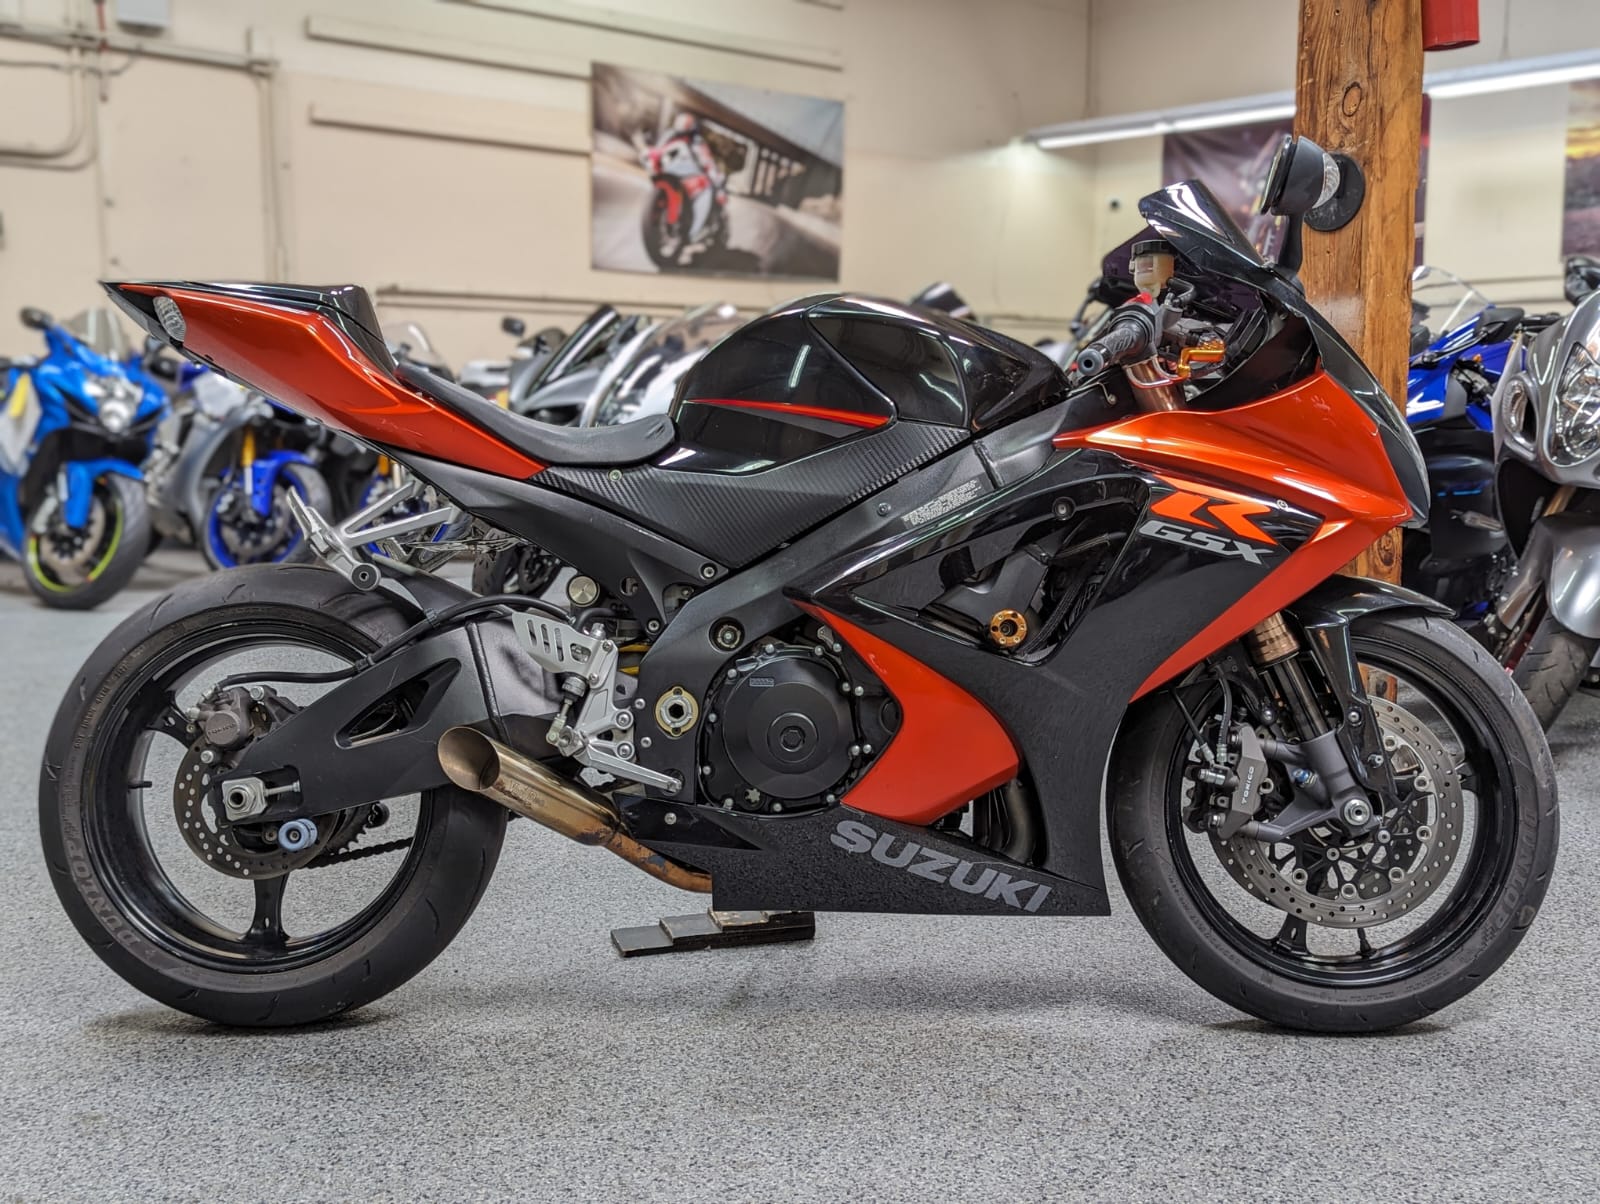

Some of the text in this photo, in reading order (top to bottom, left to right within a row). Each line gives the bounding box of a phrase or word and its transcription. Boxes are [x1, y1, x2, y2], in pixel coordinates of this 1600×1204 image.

[1138, 519, 1274, 565] GSX
[1241, 766, 1255, 804] TOKICO
[66, 839, 142, 946] DUNLOP
[830, 820, 1052, 913] SUZUKI
